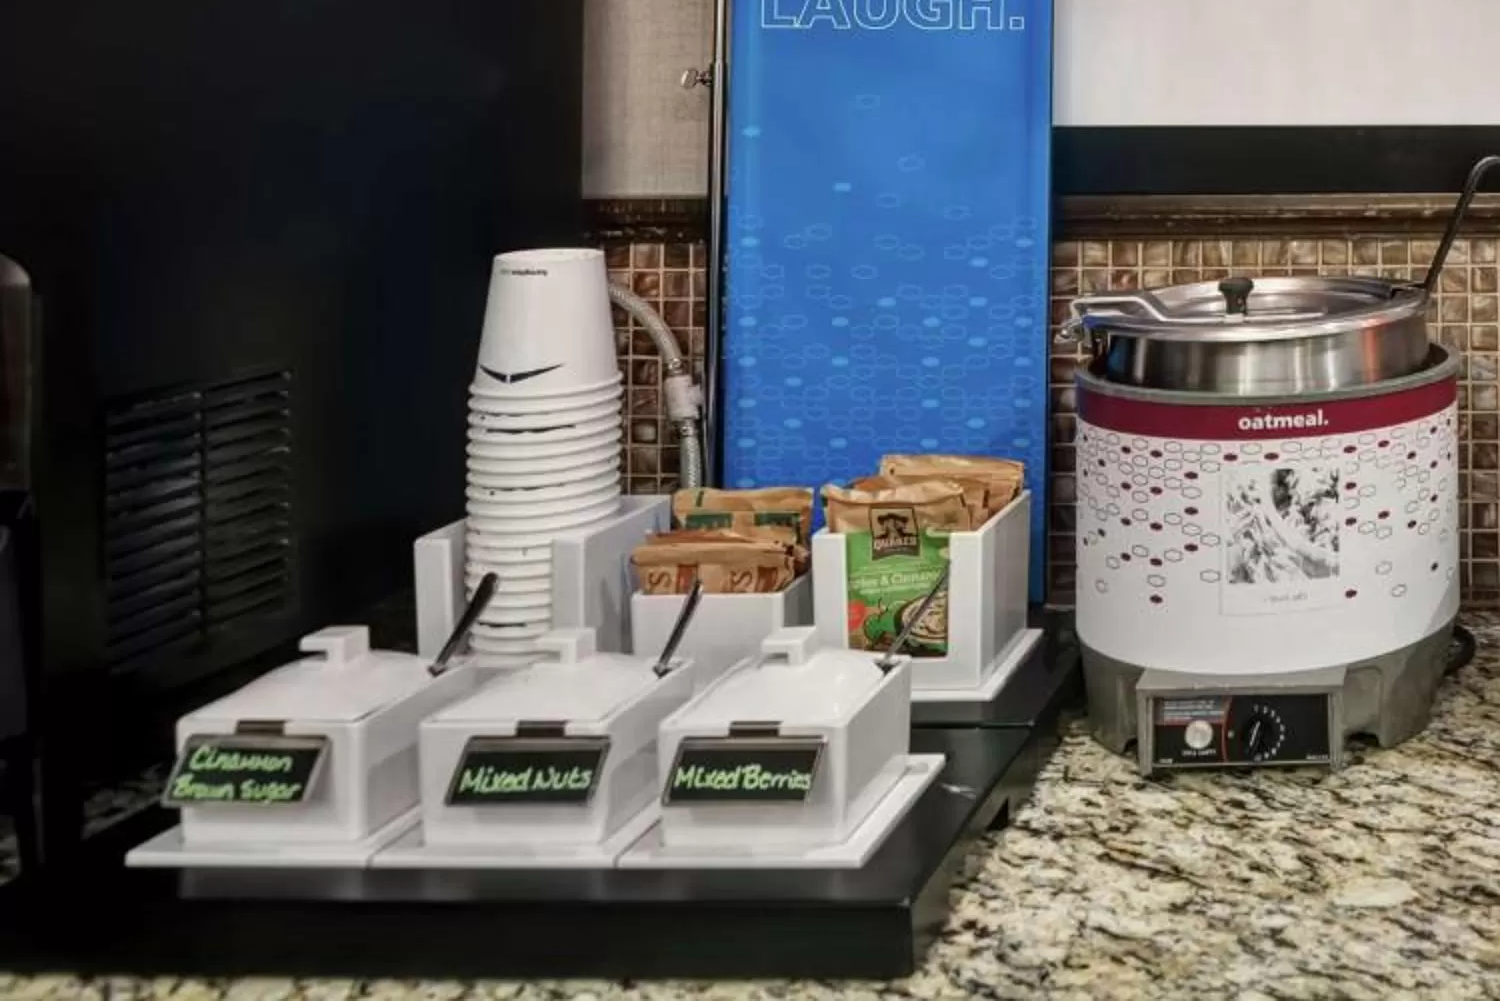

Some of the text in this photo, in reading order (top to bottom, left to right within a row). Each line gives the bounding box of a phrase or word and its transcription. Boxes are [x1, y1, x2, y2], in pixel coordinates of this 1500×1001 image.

[1238, 408, 1329, 430] oatmeal.
[173, 773, 301, 806] Brown Sugar
[459, 765, 592, 793] Mixed Nuts
[674, 763, 812, 790] Mixed Berries
